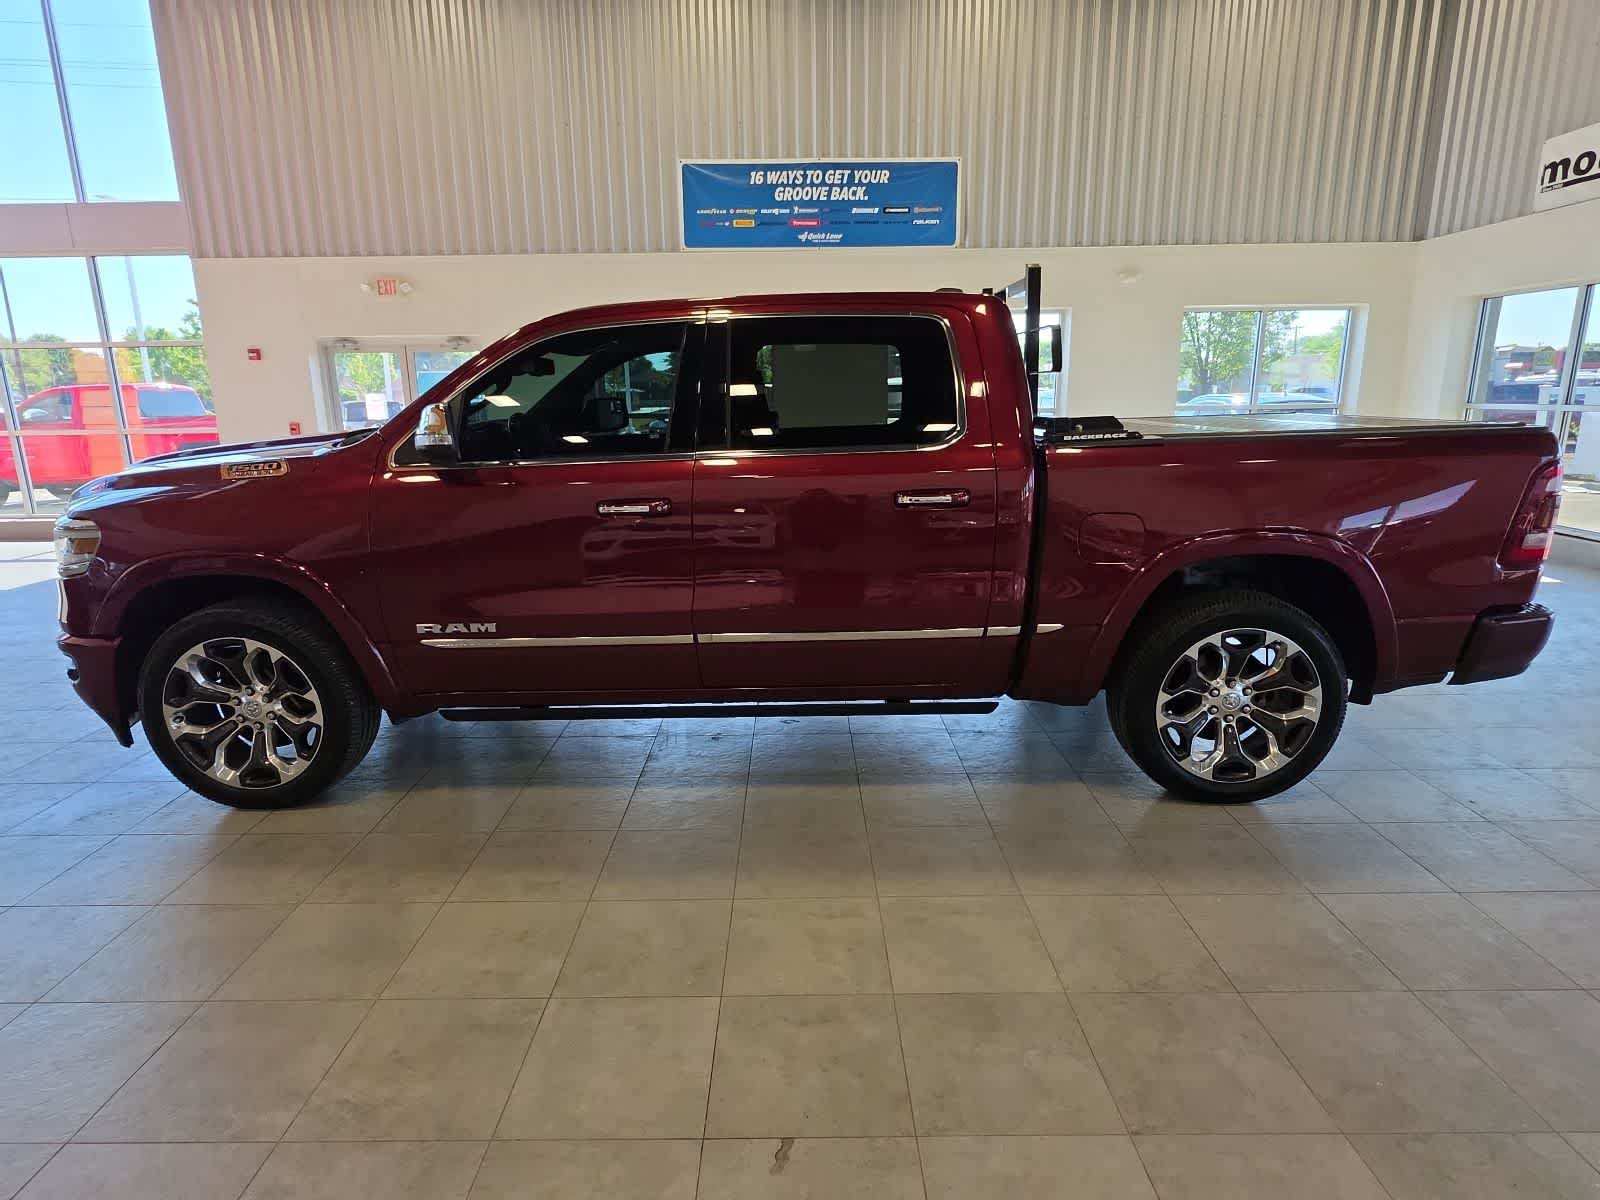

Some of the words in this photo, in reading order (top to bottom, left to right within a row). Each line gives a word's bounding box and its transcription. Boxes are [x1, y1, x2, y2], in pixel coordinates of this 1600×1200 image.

[1540, 151, 1600, 186] mo
[750, 171, 764, 185] 16
[767, 170, 804, 185] WAYS
[806, 170, 823, 184] TO
[825, 170, 852, 184] GET
[854, 169, 890, 184] YOUR
[774, 187, 829, 201] GROOVE
[831, 186, 869, 201] BACK.
[377, 280, 397, 296] EXIT
[229, 462, 281, 471] 1500
[416, 623, 497, 634] RAM
